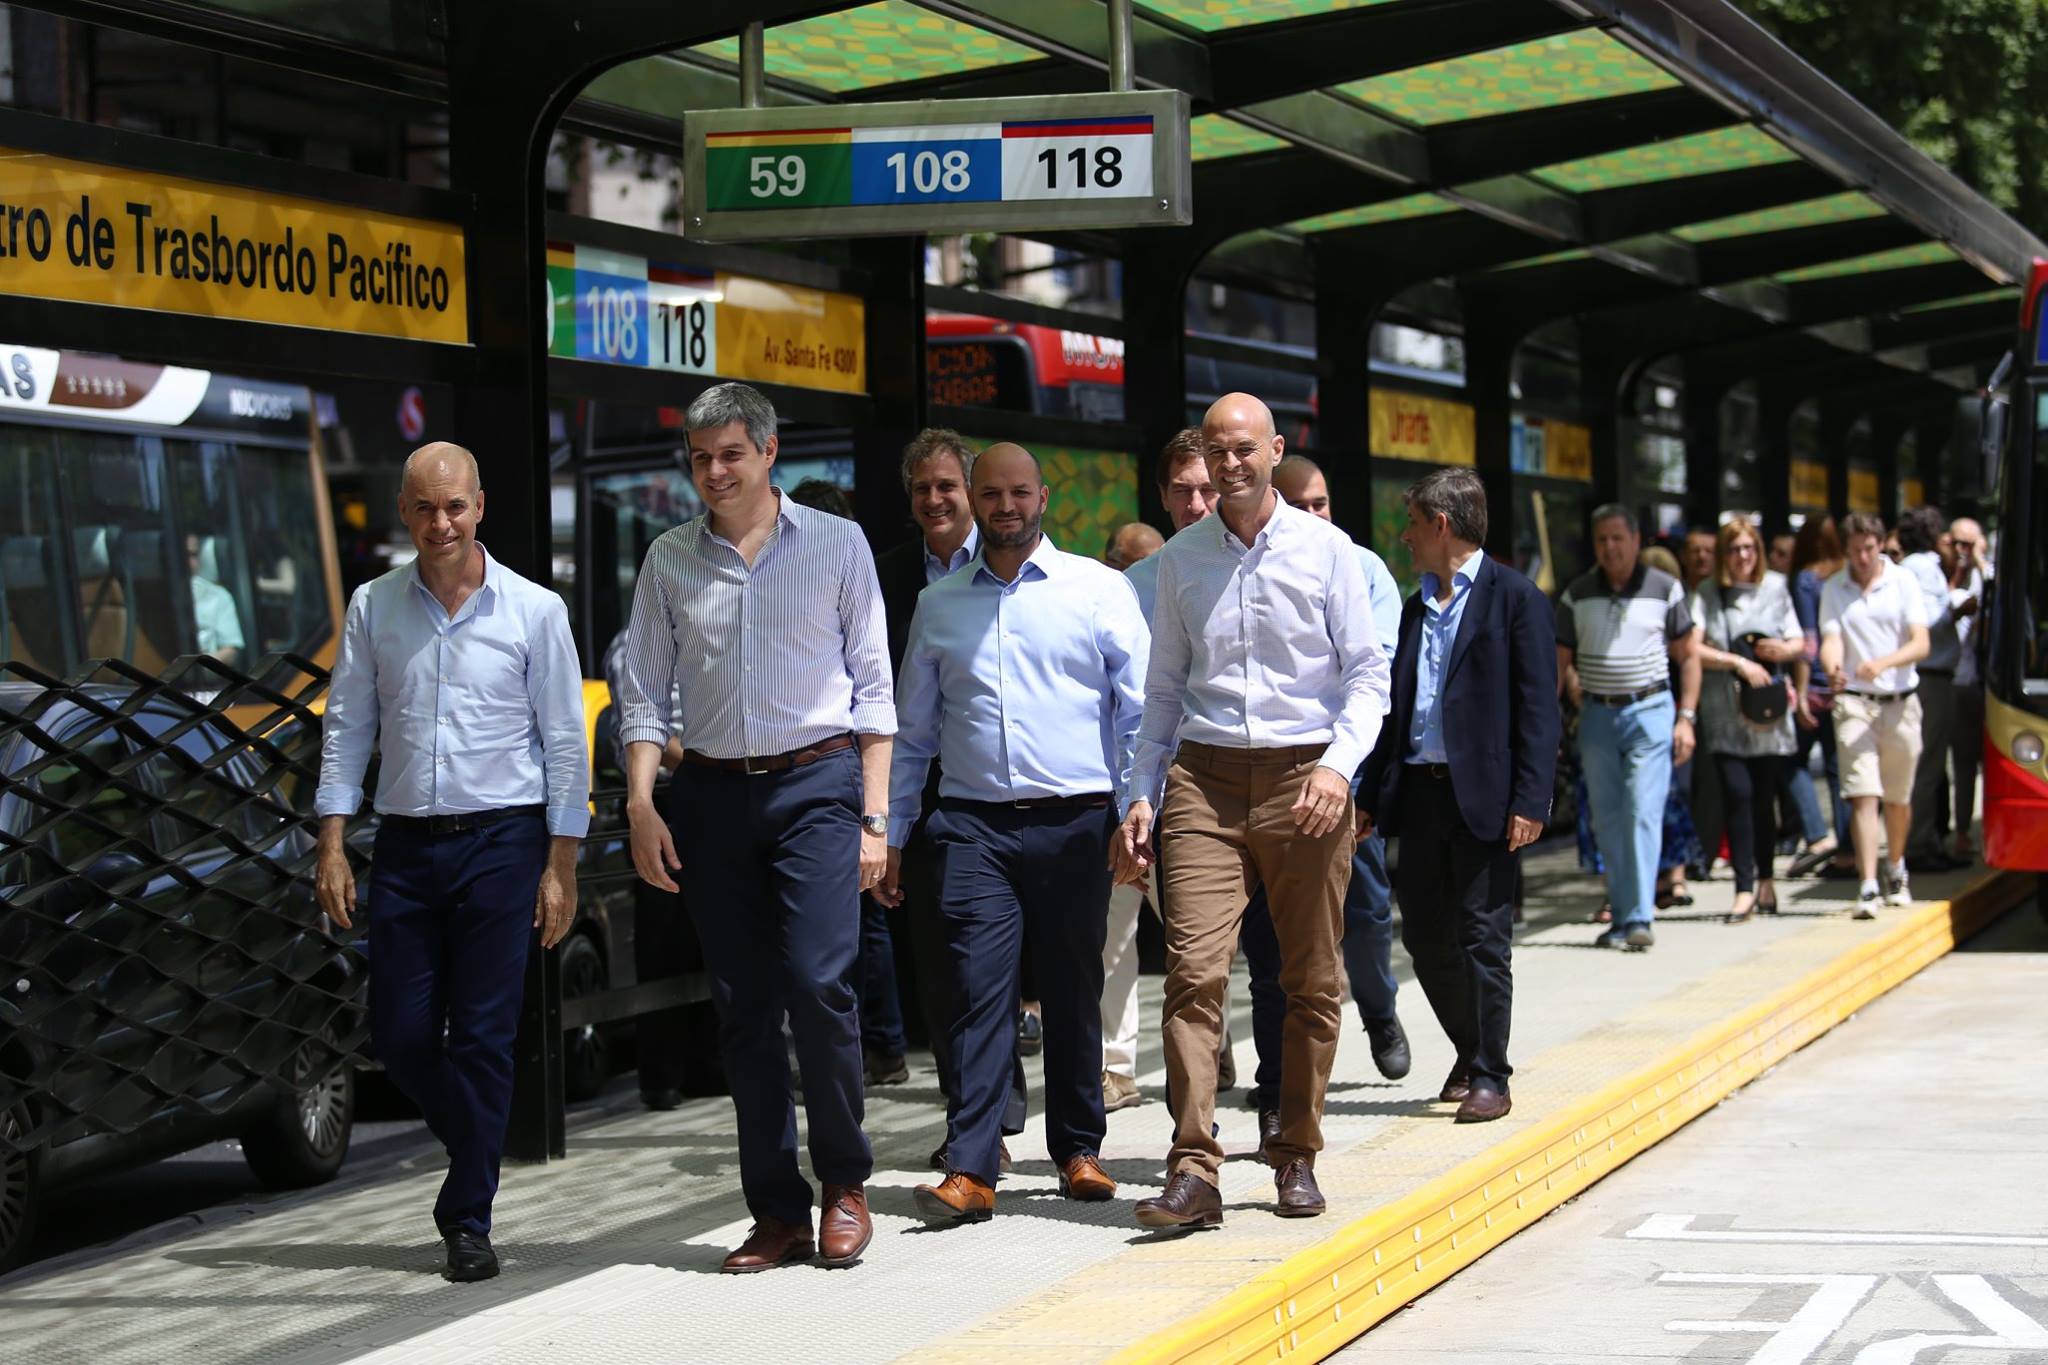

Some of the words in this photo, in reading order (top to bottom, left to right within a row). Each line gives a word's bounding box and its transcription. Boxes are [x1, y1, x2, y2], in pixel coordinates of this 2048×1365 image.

[749, 155, 806, 198] 59
[886, 150, 971, 194] 108
[1037, 146, 1123, 189] 118
[66, 195, 115, 271] de
[126, 201, 316, 296] Trasbordo
[327, 232, 449, 313] Pacífico
[586, 286, 638, 360] 108
[658, 301, 706, 368] 118
[784, 338, 816, 368] Santa
[818, 344, 832, 372] Fe
